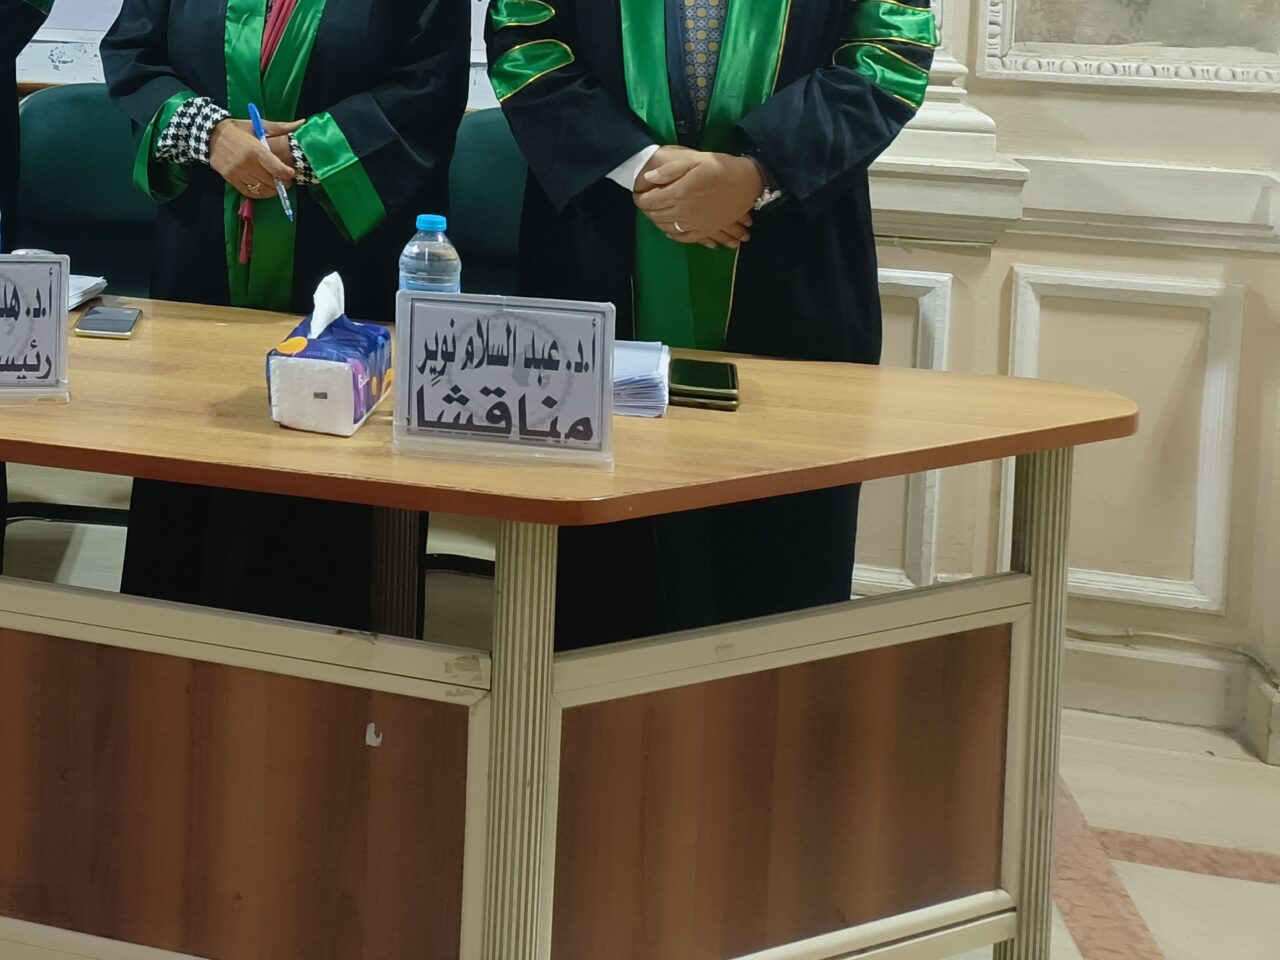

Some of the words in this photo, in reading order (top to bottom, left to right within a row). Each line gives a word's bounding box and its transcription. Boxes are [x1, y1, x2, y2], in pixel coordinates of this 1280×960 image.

[416, 318, 457, 375] نوير
[460, 318, 517, 371] السلام
[523, 330, 560, 386] عبد
